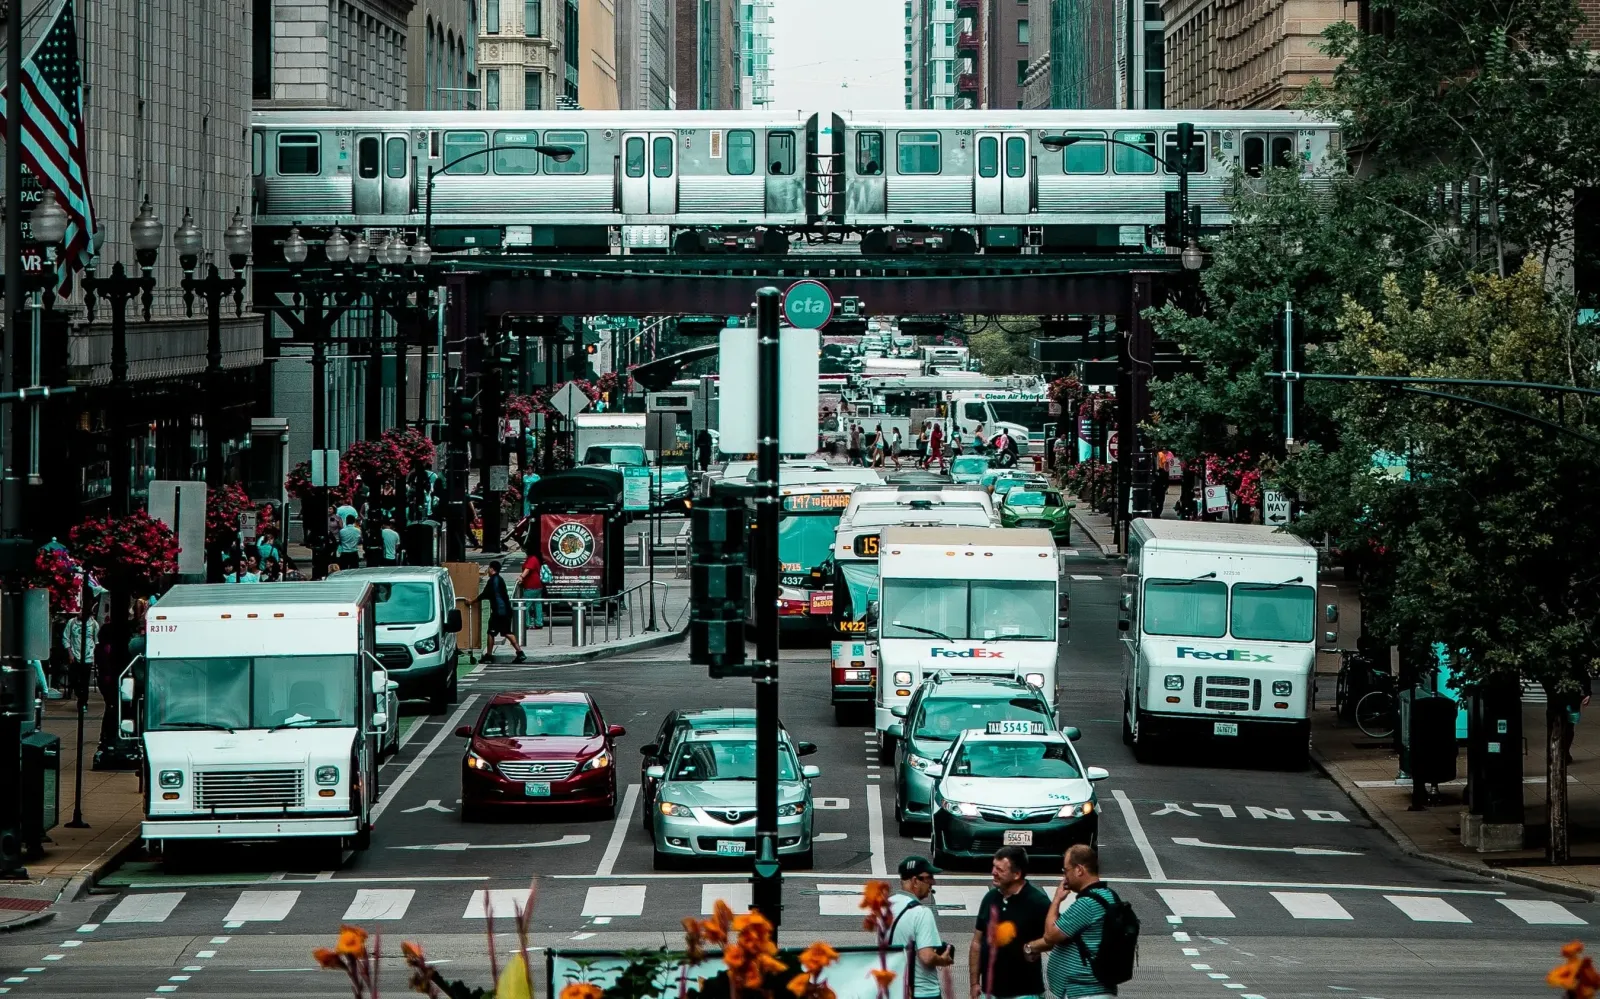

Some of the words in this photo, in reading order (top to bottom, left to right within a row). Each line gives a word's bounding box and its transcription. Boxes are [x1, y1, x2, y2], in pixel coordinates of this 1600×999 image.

[20, 191, 43, 202] PAC
[791, 297, 825, 314] cta
[1020, 393, 1044, 401] Hybrid
[792, 495, 811, 509] 147
[812, 497, 821, 506] TO
[821, 495, 851, 507] HOWAR
[1267, 493, 1286, 502] ON
[1267, 503, 1287, 511] WAY
[552, 524, 592, 541] BLACKHAWKS
[863, 537, 880, 555] 15
[552, 551, 591, 566] CONVENTION
[782, 577, 804, 585] 4337
[840, 621, 866, 632] K422
[931, 647, 1005, 659] FedEx
[1176, 646, 1270, 664] FedEx
[1003, 722, 1029, 733] 5545
[1031, 722, 1044, 734] TAXI
[1048, 793, 1071, 801] 5545
[1151, 803, 1350, 822] ONLY
